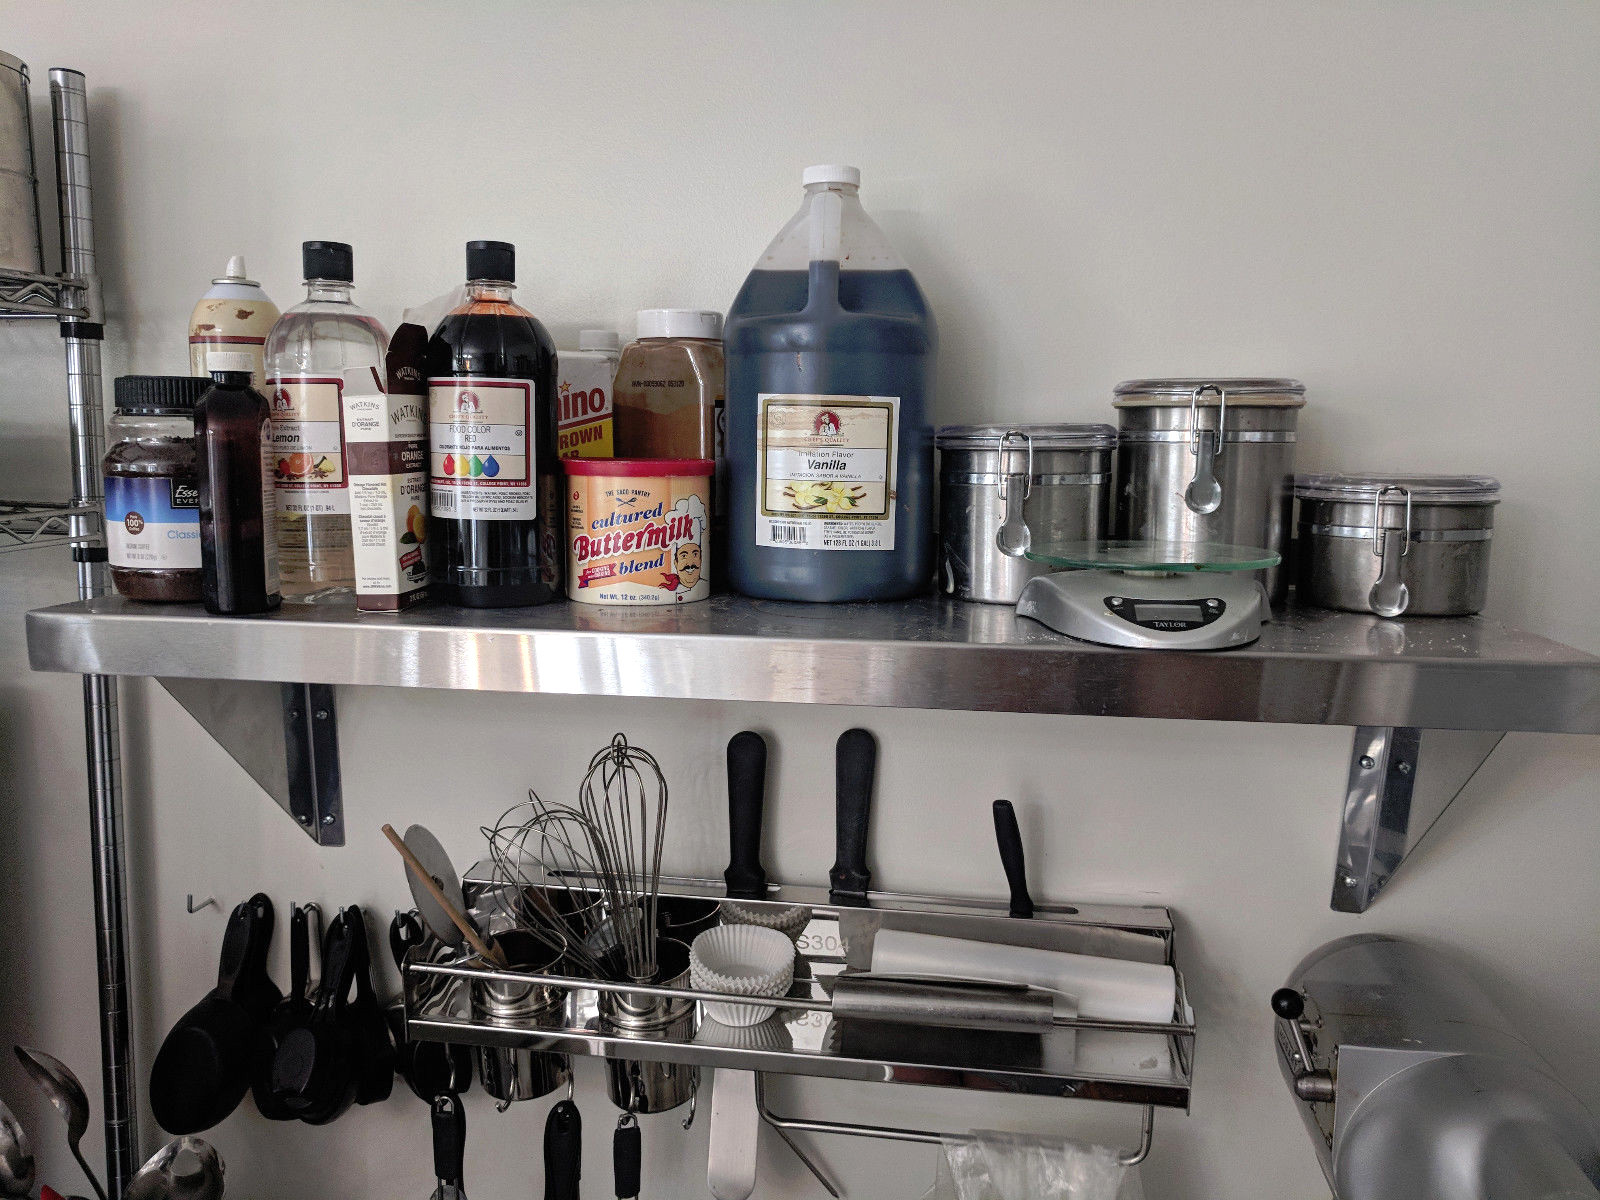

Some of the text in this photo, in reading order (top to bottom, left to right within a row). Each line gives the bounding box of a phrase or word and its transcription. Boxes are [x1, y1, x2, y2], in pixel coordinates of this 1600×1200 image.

[349, 401, 380, 411] WATKINS
[798, 450, 830, 458] Imitation
[807, 459, 847, 471] Vanilla
[605, 489, 614, 497] THE
[631, 489, 651, 497] PANTRY
[591, 501, 663, 530] cultured
[126, 519, 143, 527] 100%
[573, 513, 694, 562] Buttermilk
[618, 552, 665, 575] blend
